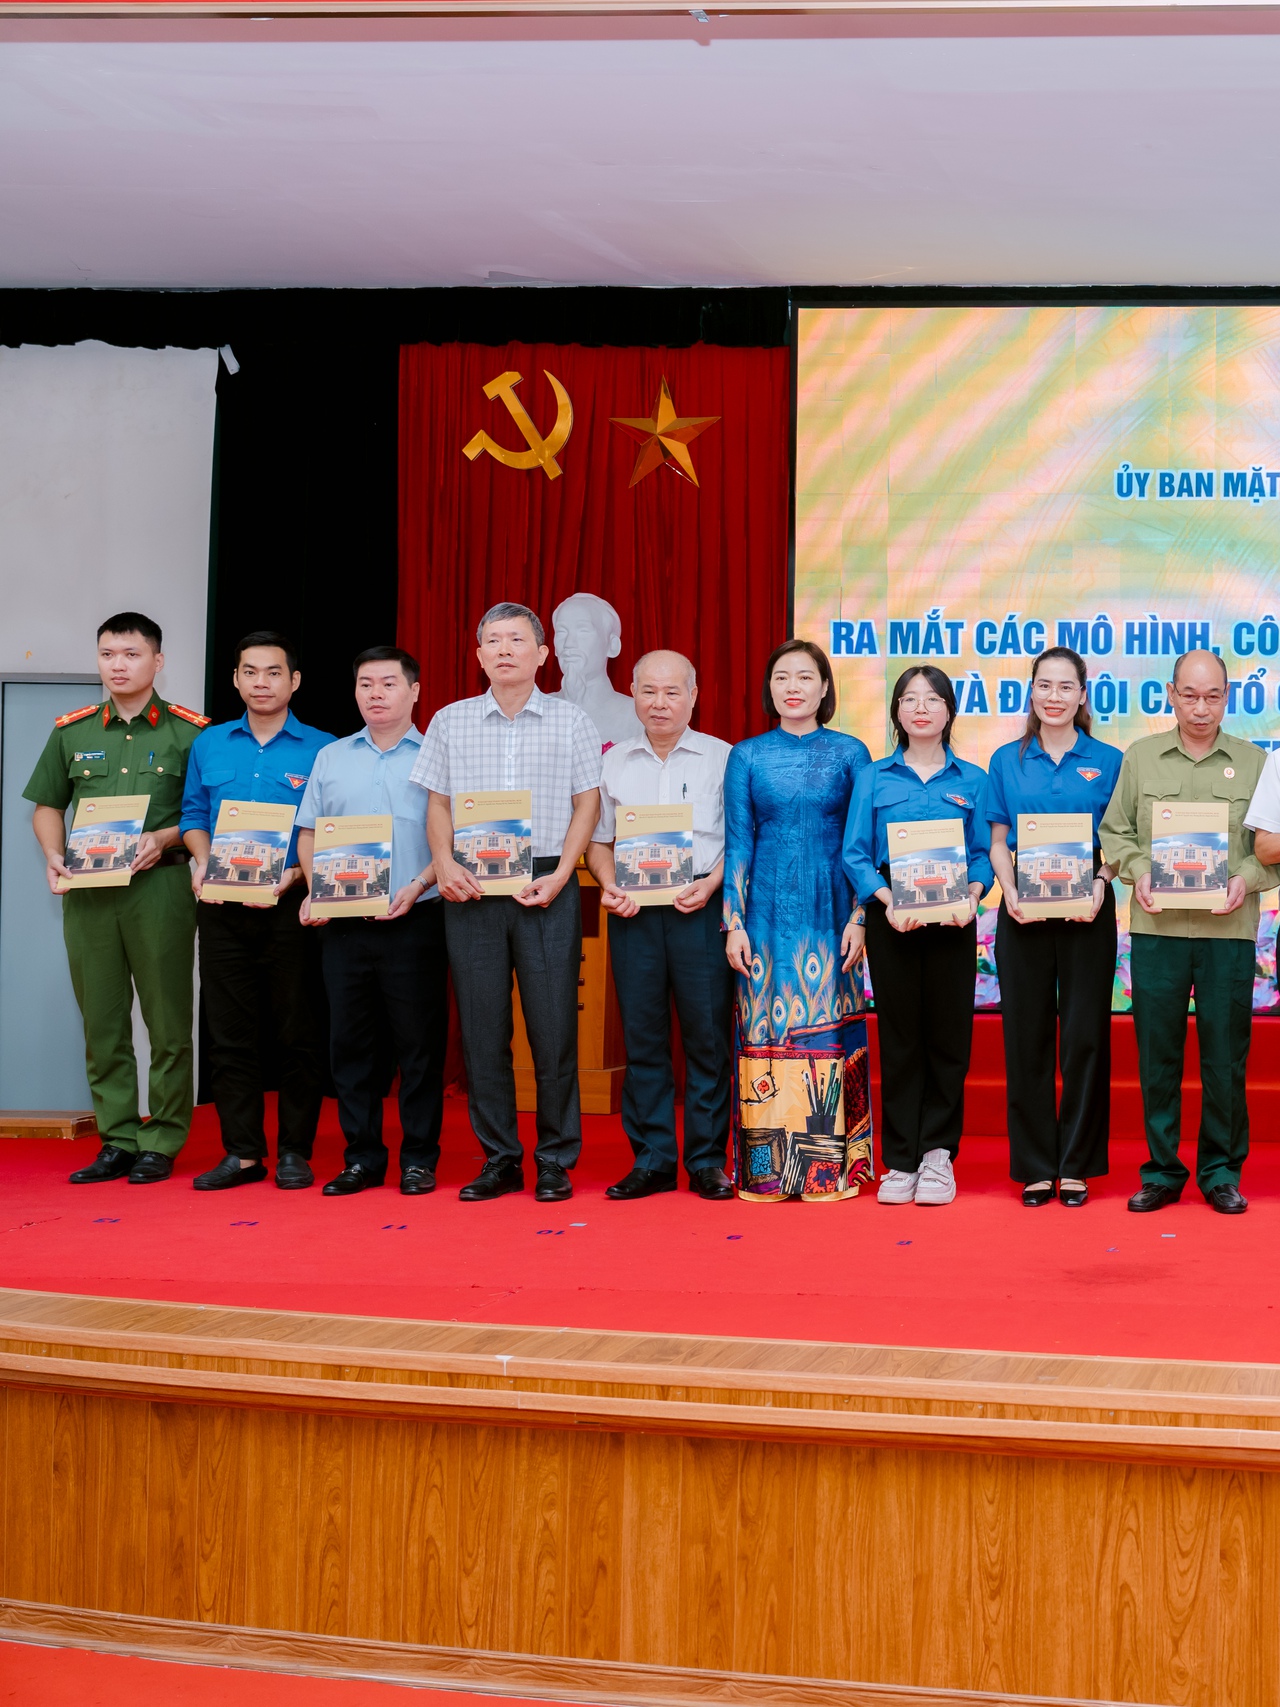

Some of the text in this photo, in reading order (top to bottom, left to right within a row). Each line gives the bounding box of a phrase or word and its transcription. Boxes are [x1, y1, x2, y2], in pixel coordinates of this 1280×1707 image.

[1116, 463, 1150, 498] ỦY
[1160, 472, 1214, 498] BAN
[832, 621, 878, 655] RA
[889, 608, 964, 655] MẮT
[975, 614, 1045, 656] CÁC
[1058, 614, 1114, 656] MÔ
[1125, 614, 1222, 657] HÌNH,
[1086, 673, 1128, 722] ỘI
